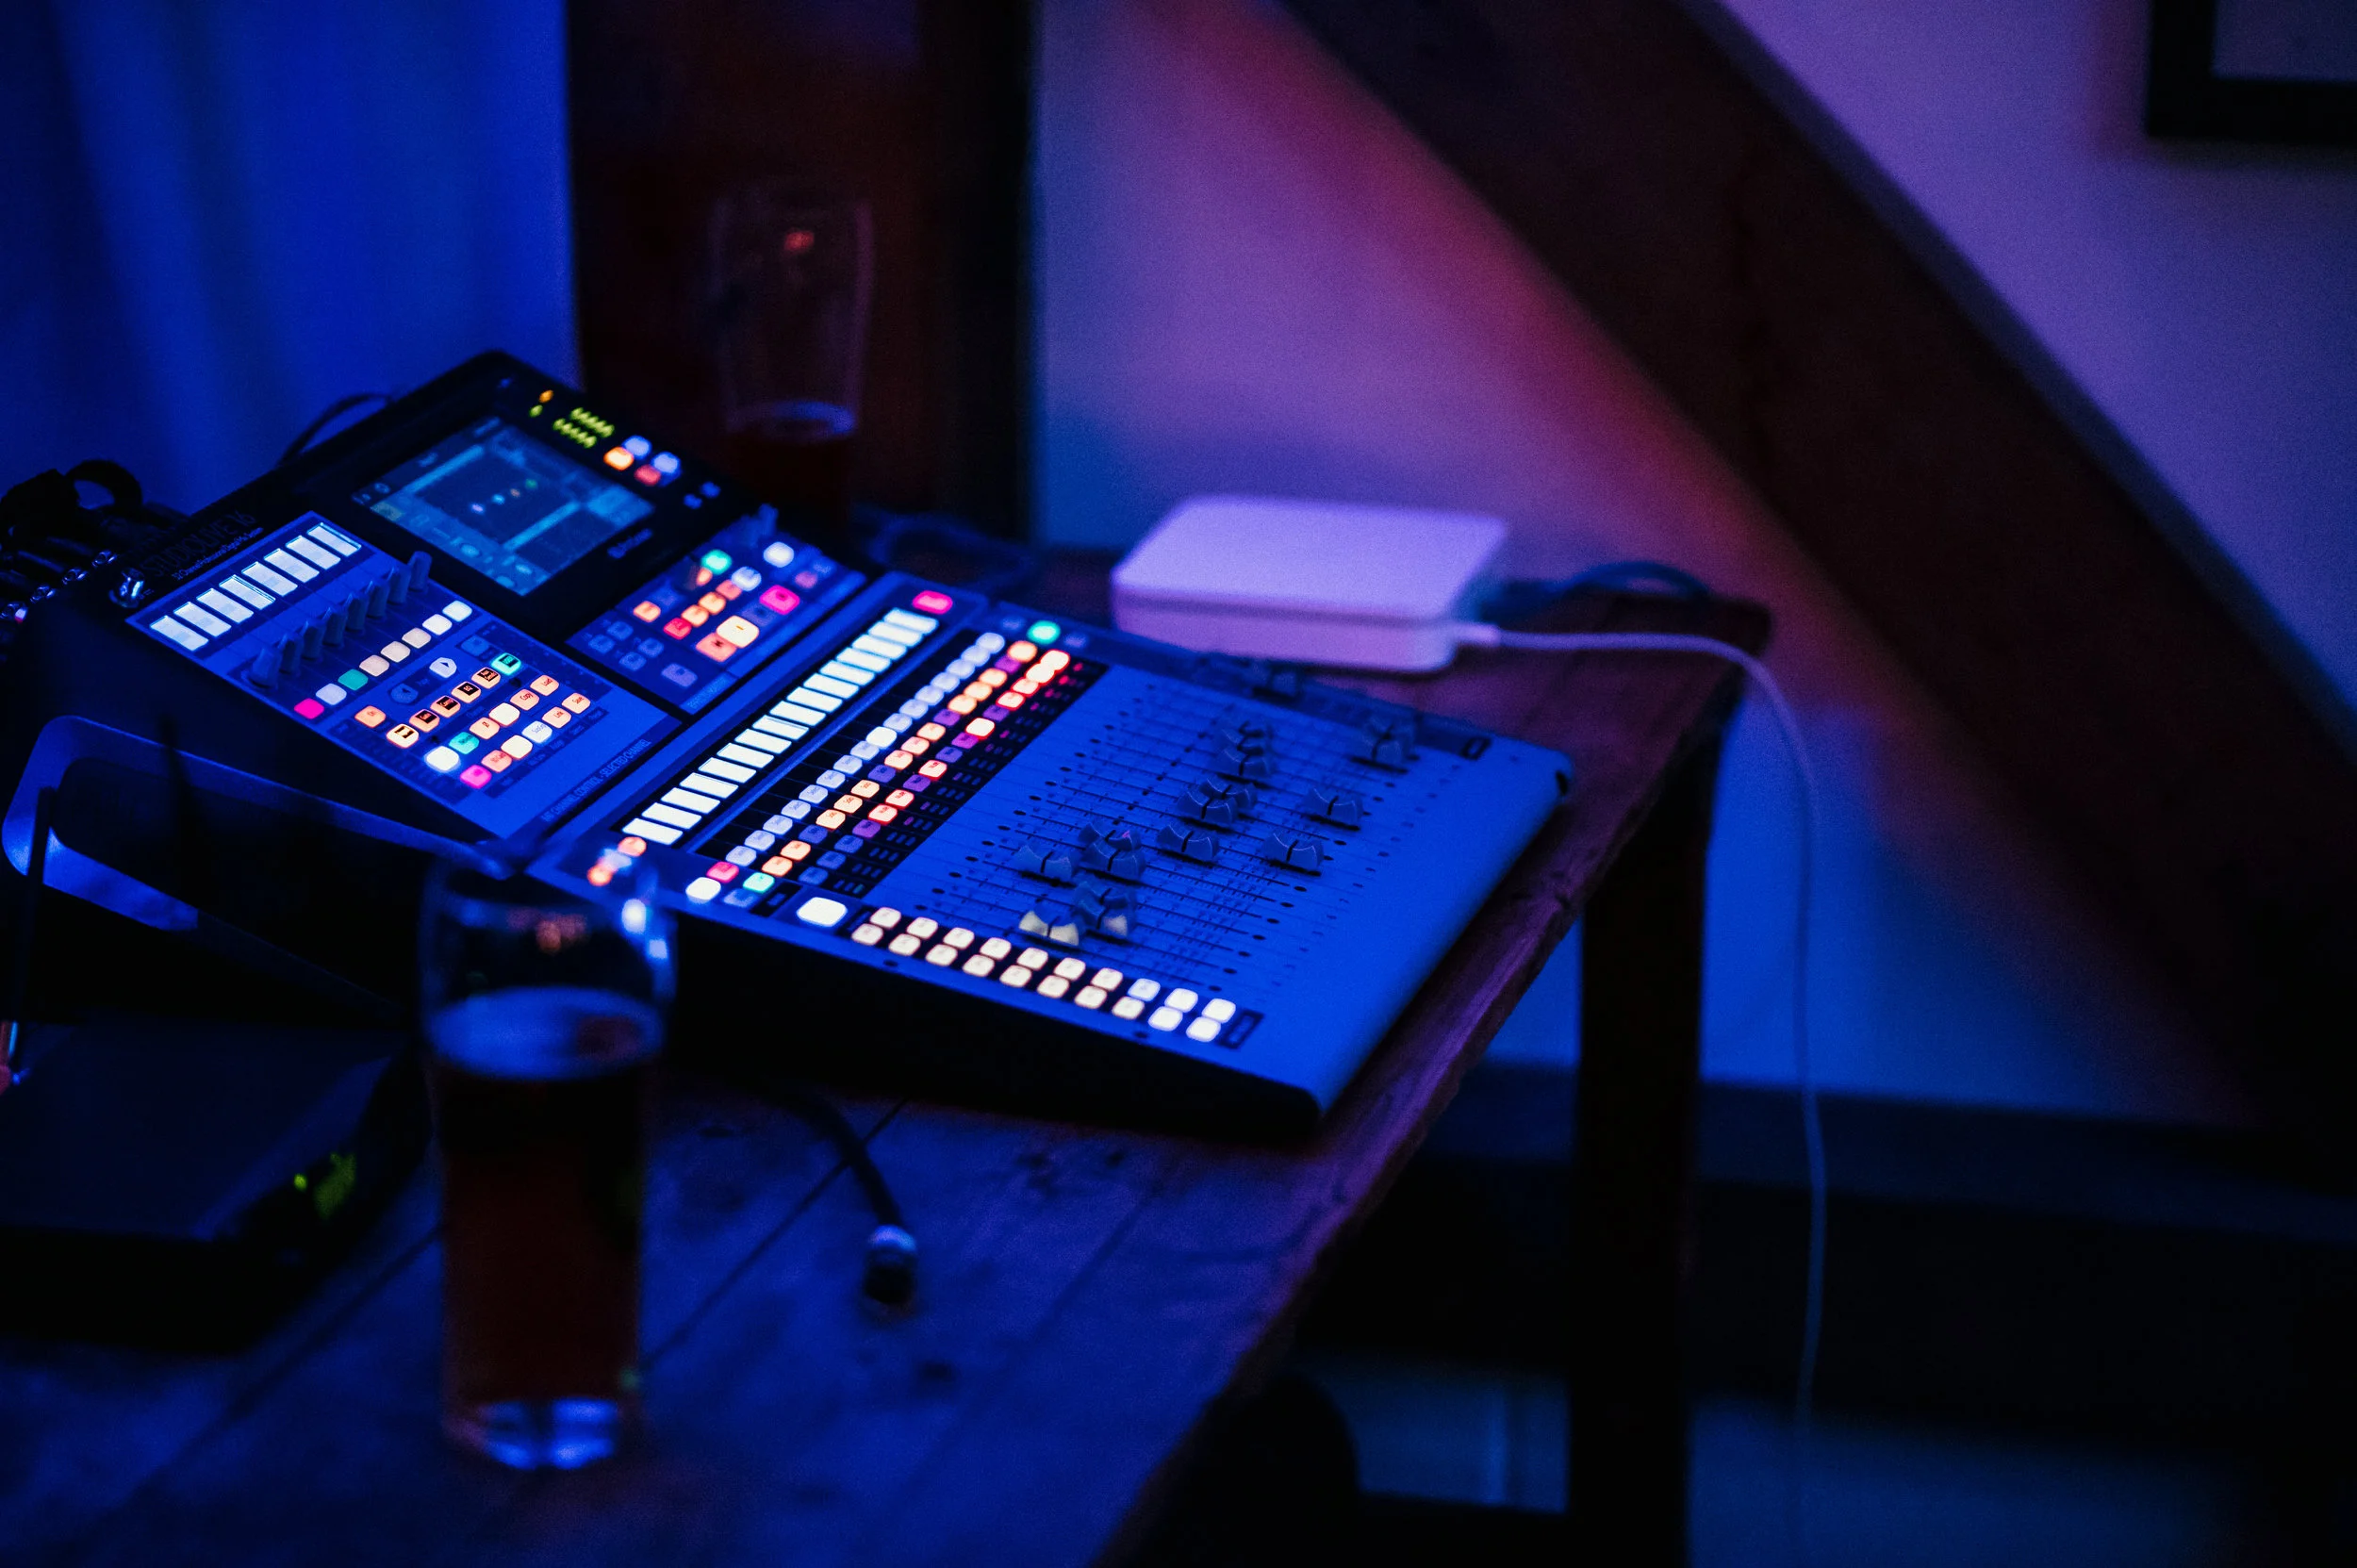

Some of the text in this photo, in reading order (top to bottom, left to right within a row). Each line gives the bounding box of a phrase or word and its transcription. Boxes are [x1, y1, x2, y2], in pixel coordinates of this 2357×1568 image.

[519, 692, 534, 701] Copy
[599, 757, 628, 778] SELECTED
[623, 738, 651, 762] CHANNEL
